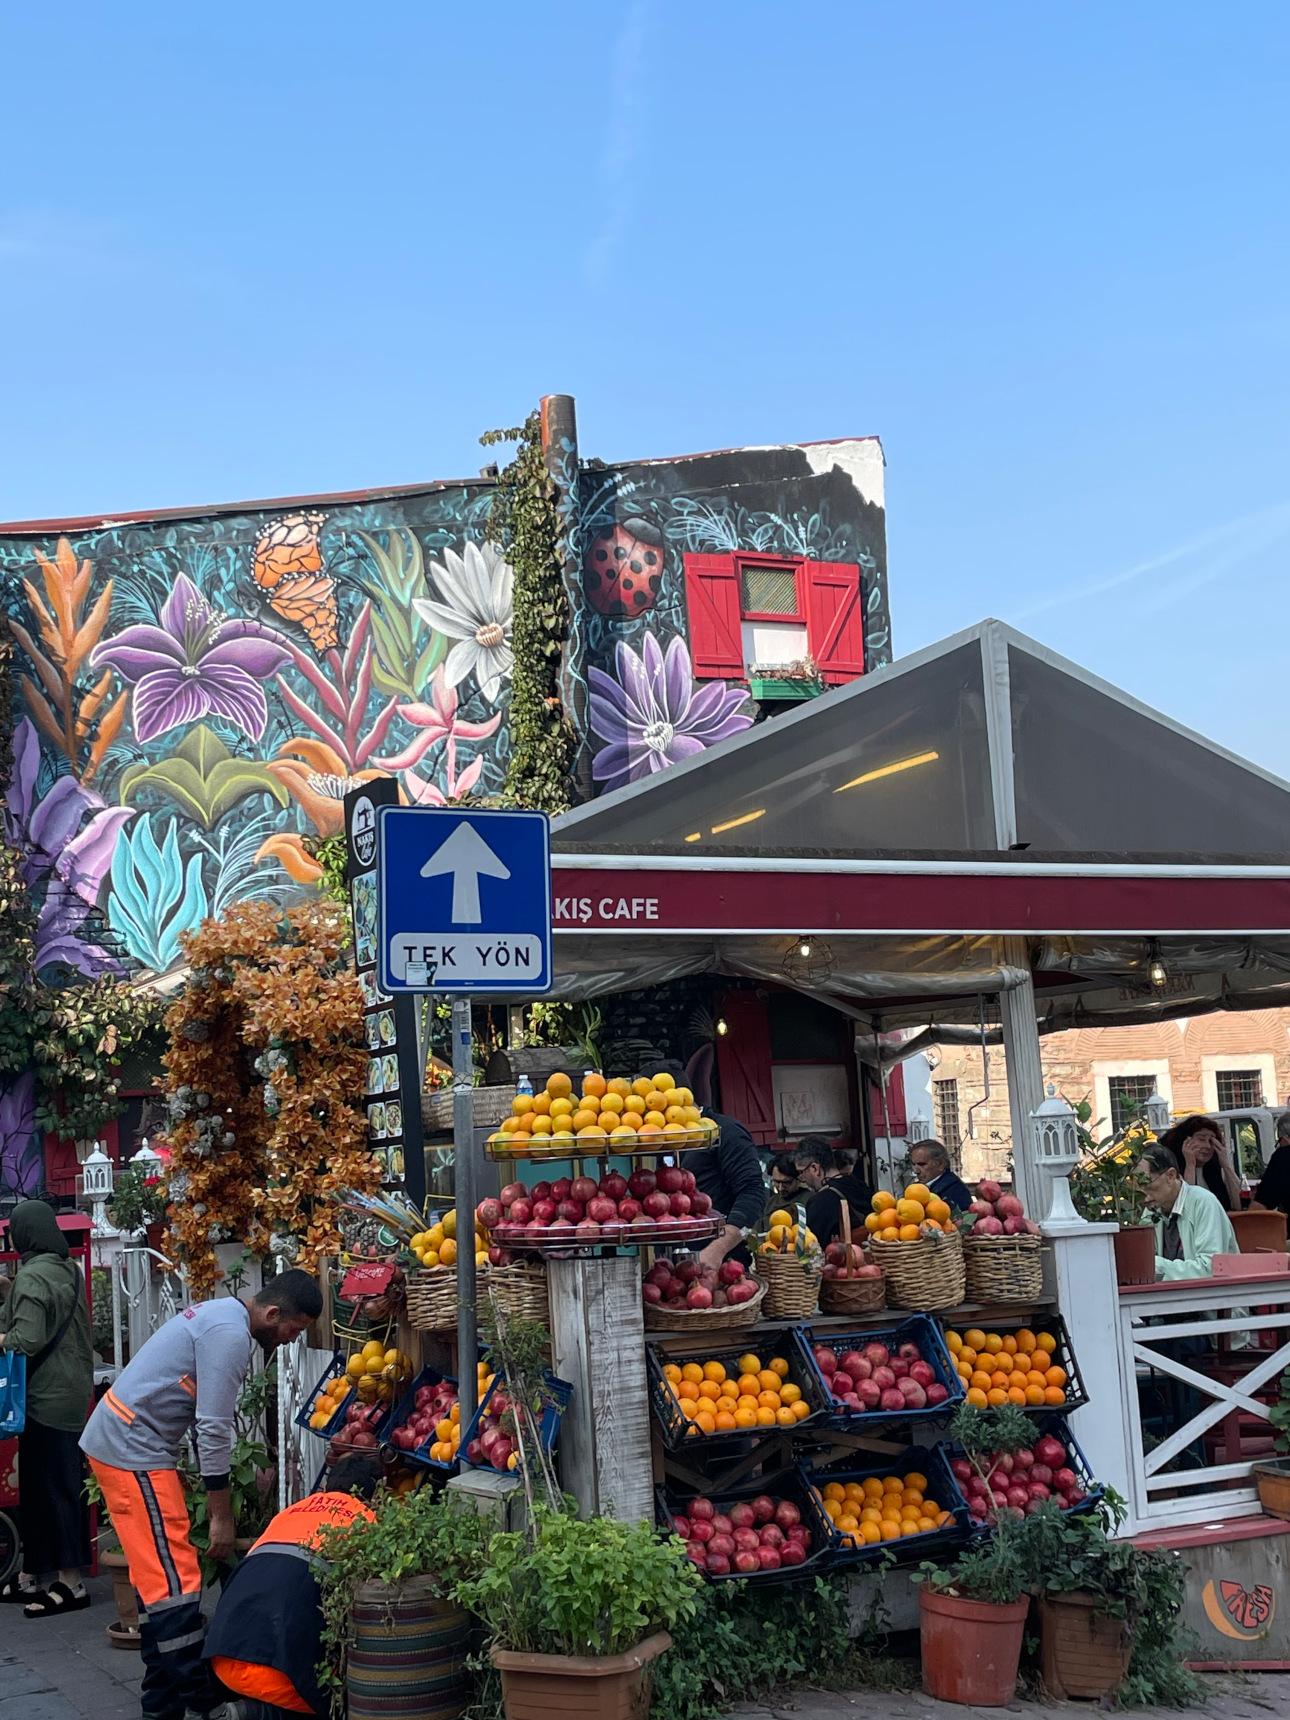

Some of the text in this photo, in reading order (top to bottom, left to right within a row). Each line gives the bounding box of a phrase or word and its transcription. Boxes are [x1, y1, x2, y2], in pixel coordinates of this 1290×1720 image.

[551, 898, 659, 923] KIŞ CAFE
[403, 941, 530, 967] TEK YÖN
